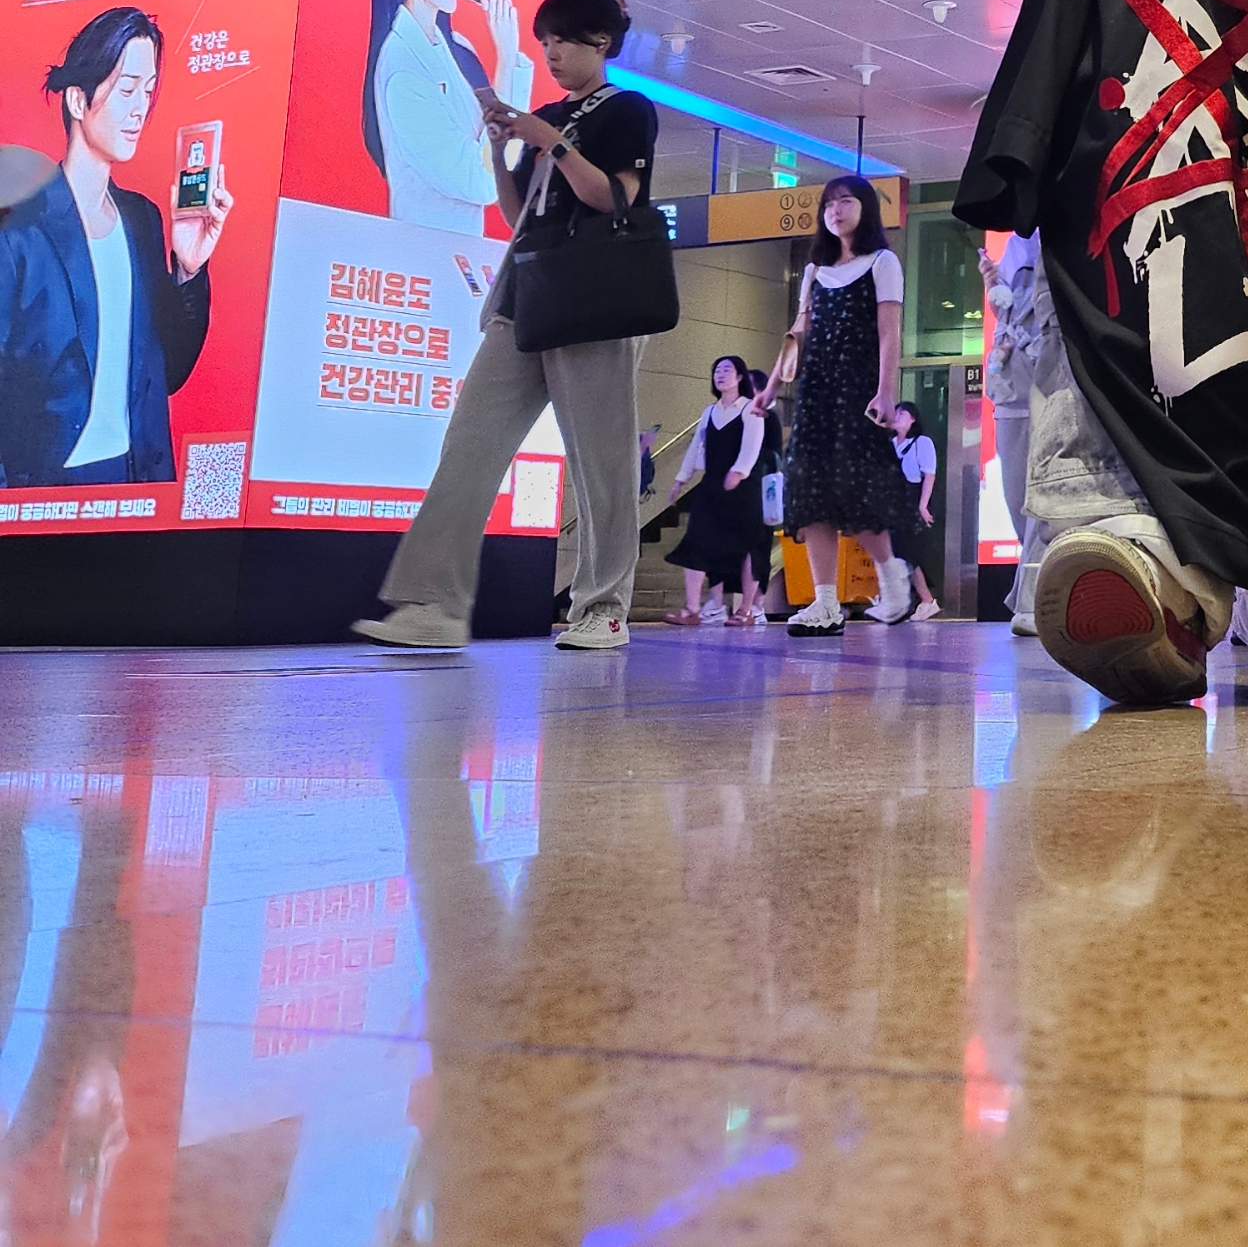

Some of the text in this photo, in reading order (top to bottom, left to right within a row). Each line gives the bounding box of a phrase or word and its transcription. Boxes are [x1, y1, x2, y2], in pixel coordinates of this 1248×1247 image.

[189, 30, 229, 52] 건강은
[187, 50, 251, 74] 정관장으로
[329, 262, 432, 311] 김혜윤도
[325, 312, 451, 361] 정관장으로
[319, 363, 424, 408] 건강관리
[966, 368, 980, 381] B1
[21, 501, 79, 521] 궁금하다면
[79, 500, 118, 519] 스캔해
[117, 498, 157, 517] 보세요
[271, 495, 310, 515] 그들의
[309, 497, 336, 517] 관리
[335, 498, 372, 518] 비법이
